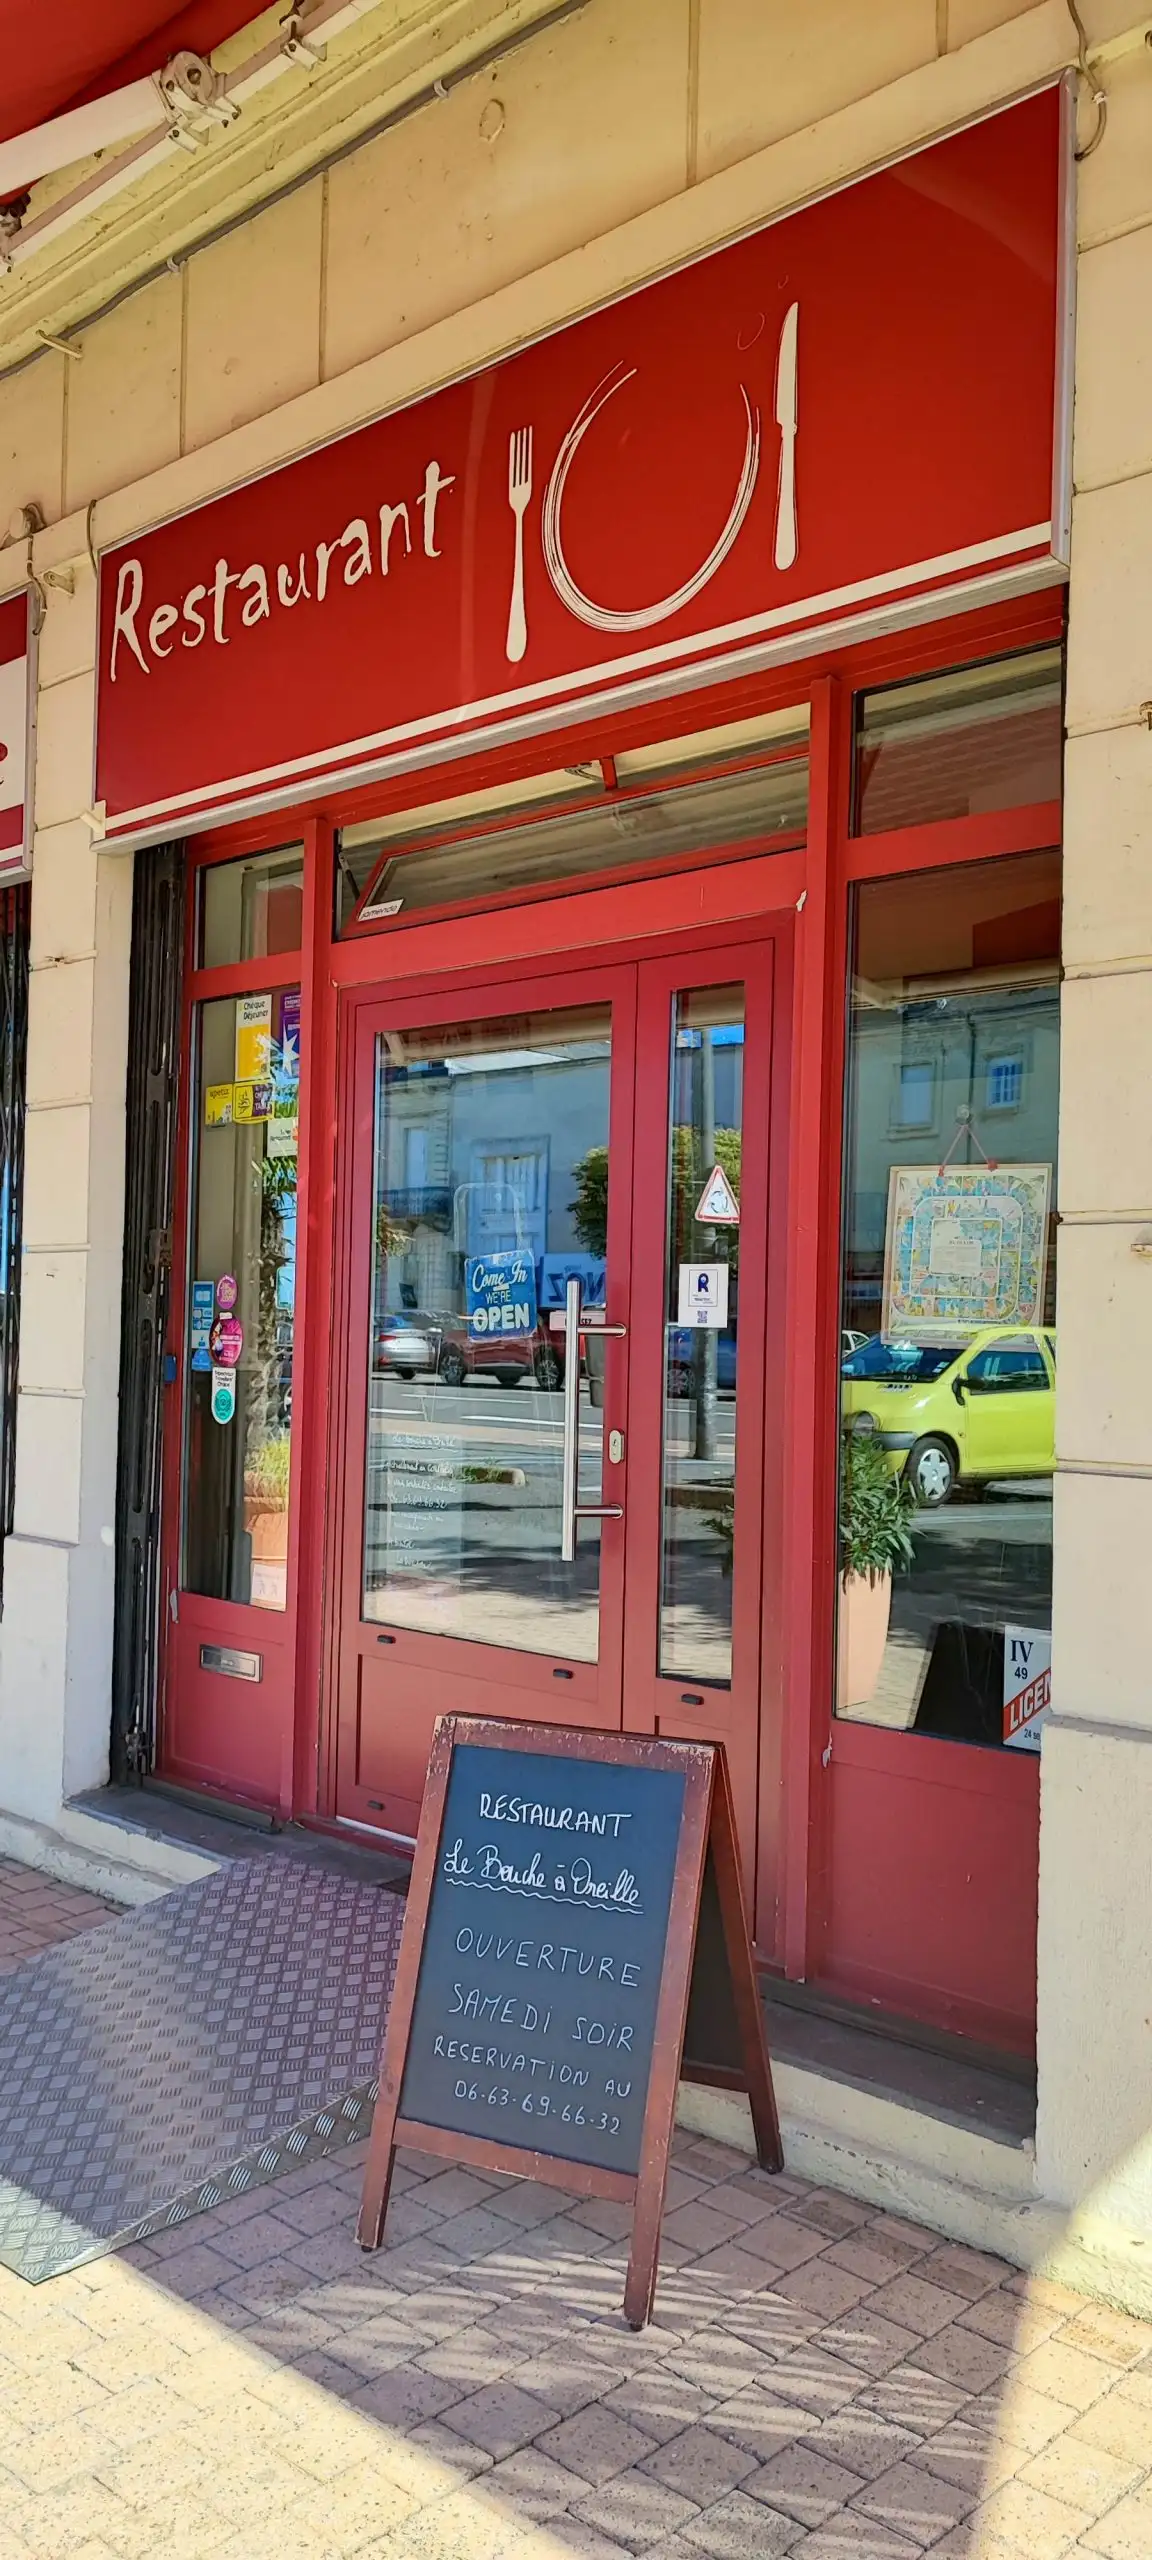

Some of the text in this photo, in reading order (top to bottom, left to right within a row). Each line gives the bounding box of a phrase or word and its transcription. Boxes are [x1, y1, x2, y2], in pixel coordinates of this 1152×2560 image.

[109, 460, 457, 683] Restaurant
[472, 1259, 529, 1293] Come In
[472, 1302, 530, 1333] OPEN
[1010, 1639, 1034, 1663] IV
[1014, 1666, 1028, 1680] 49
[1023, 1728, 1032, 1739] 24
[479, 1793, 632, 1837] RESTAURANT
[443, 1838, 475, 1874] Le
[476, 1844, 547, 1888] Bouche
[571, 1857, 644, 1907] Oreille
[456, 1927, 641, 1988] OUVERTURE
[448, 1983, 634, 2052] SAMEDI SOIR
[433, 2035, 632, 2099] RESERVATION AU
